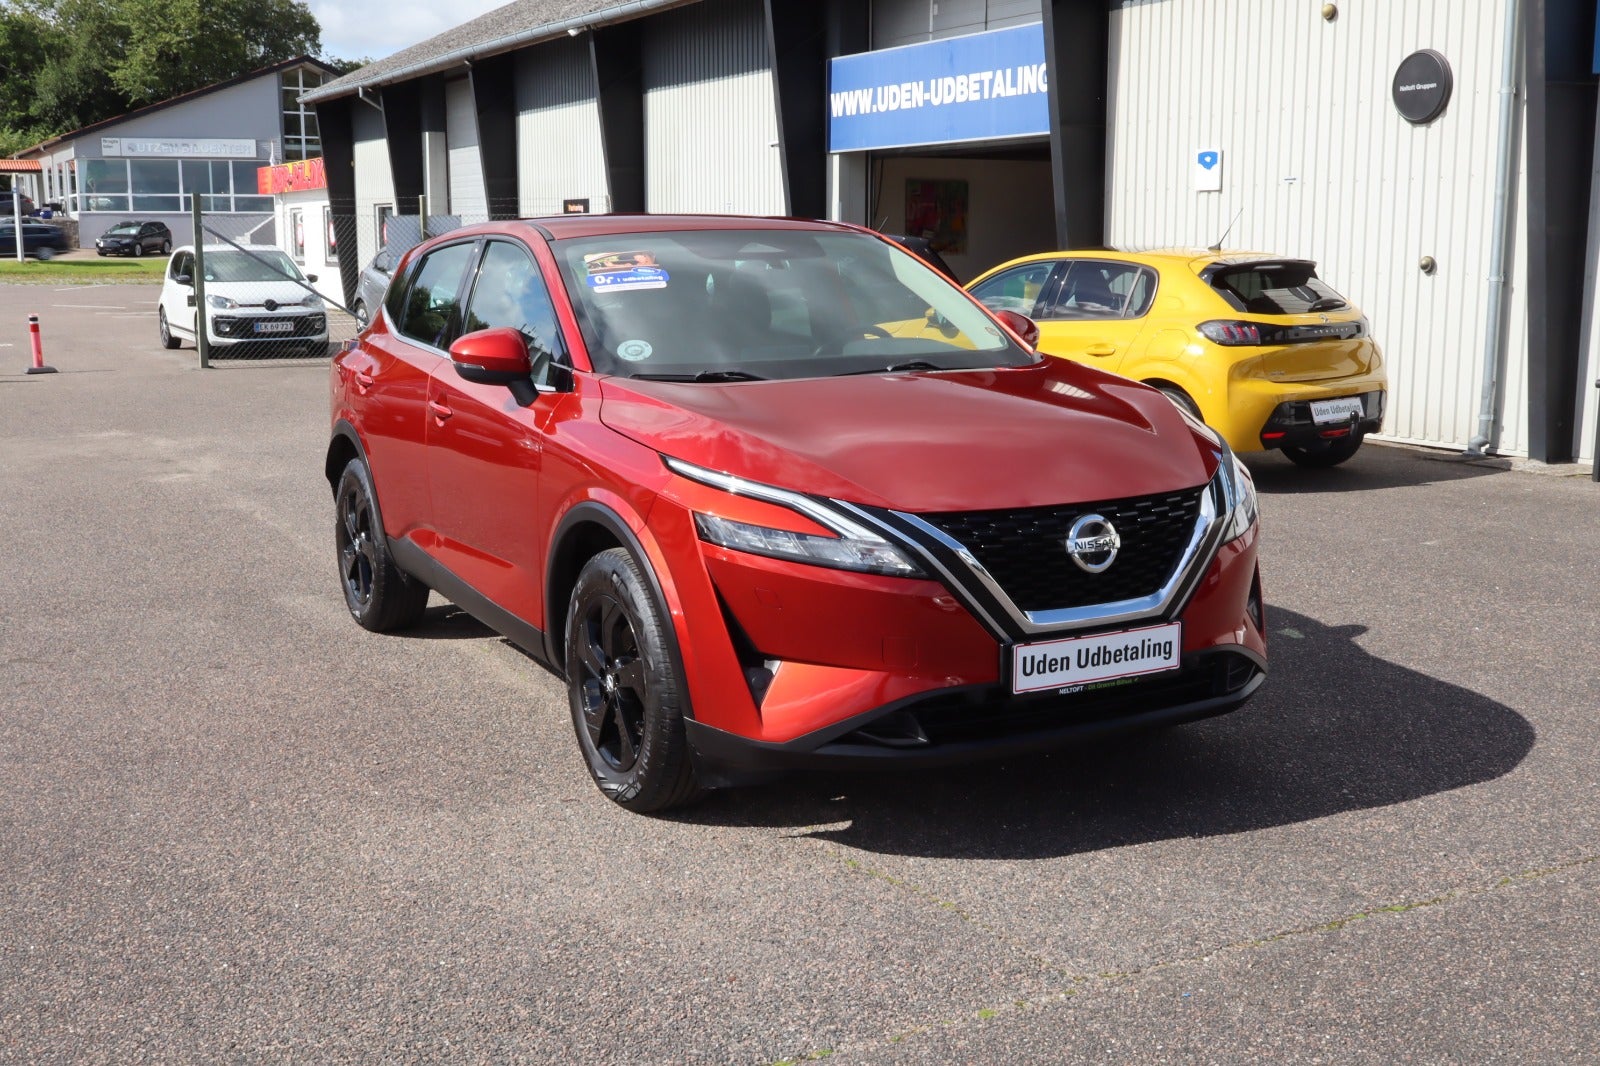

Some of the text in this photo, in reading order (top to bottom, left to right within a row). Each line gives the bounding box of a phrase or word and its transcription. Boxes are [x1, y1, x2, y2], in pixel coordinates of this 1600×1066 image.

[1314, 407, 1330, 416] Uden
[1074, 538, 1116, 550] NISSAN
[1022, 638, 1173, 677] Uden Udbetaling
[1059, 685, 1084, 695] NELTOFT
